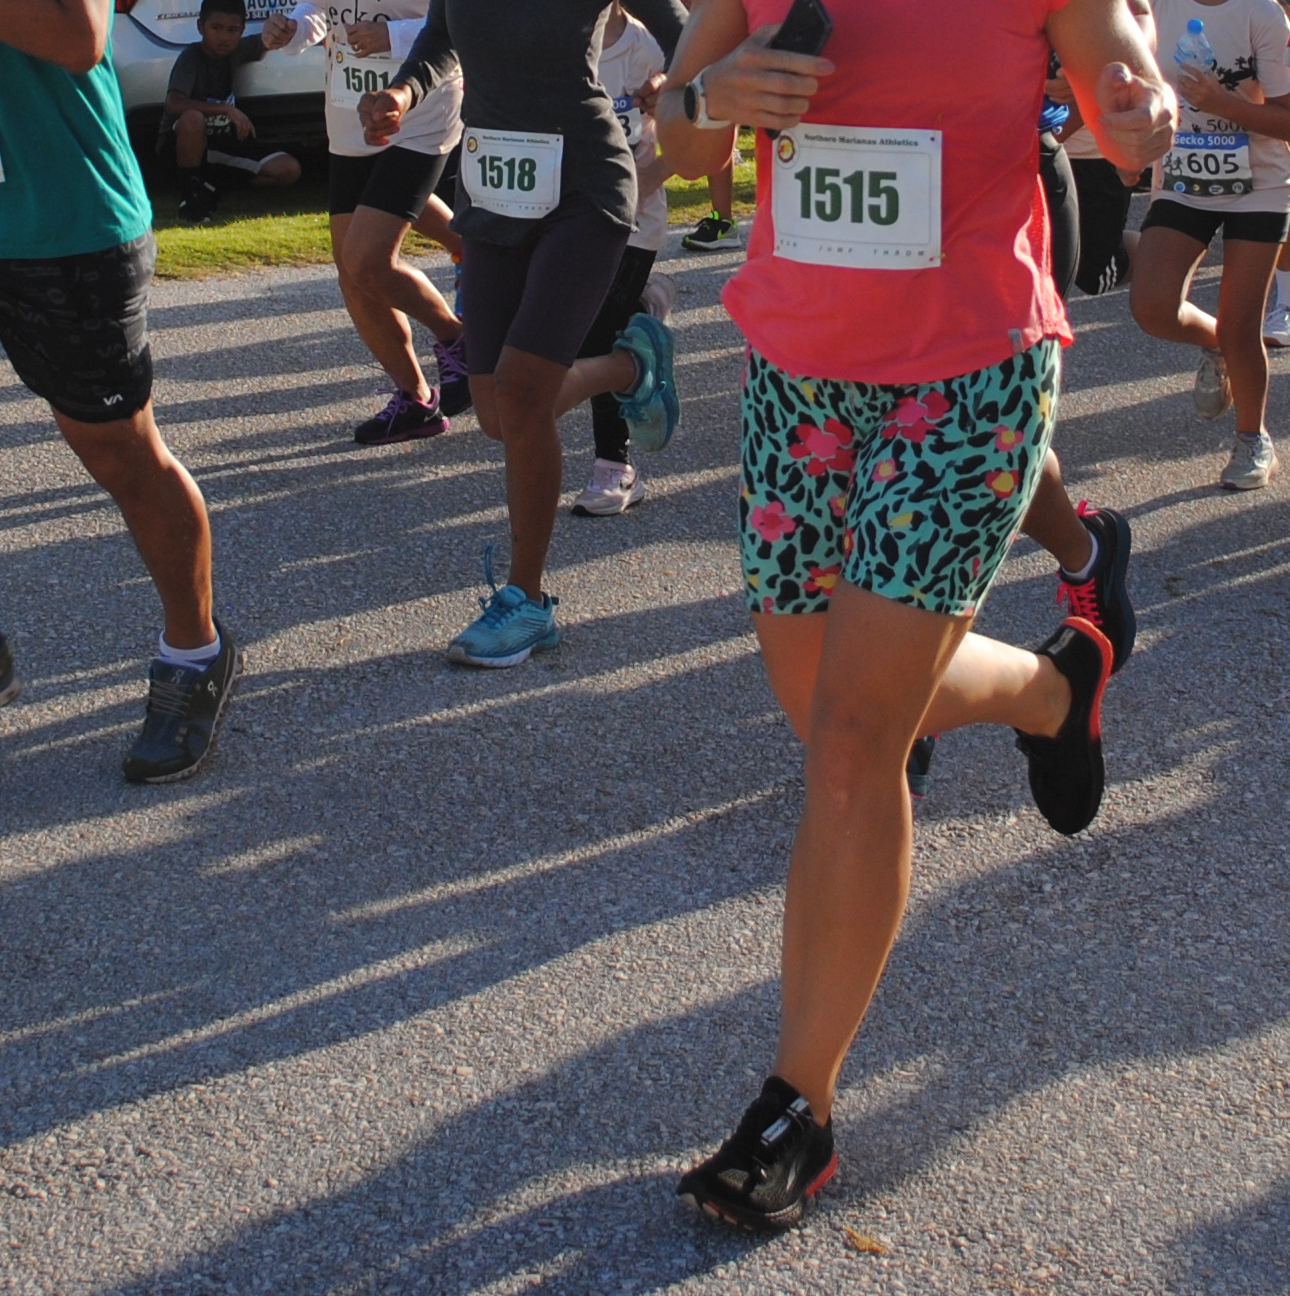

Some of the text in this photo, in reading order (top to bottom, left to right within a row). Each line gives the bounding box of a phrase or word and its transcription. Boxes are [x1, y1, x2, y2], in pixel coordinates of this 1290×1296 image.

[343, 66, 389, 93] 1501
[804, 133, 919, 147] Northern Marianas Athletics
[1173, 134, 1236, 145] Gecko 5000
[477, 154, 537, 192] 1518
[1186, 152, 1240, 175] 605
[794, 166, 900, 226] 1515
[819, 245, 853, 254] JUMP
[873, 249, 925, 257] THROW
